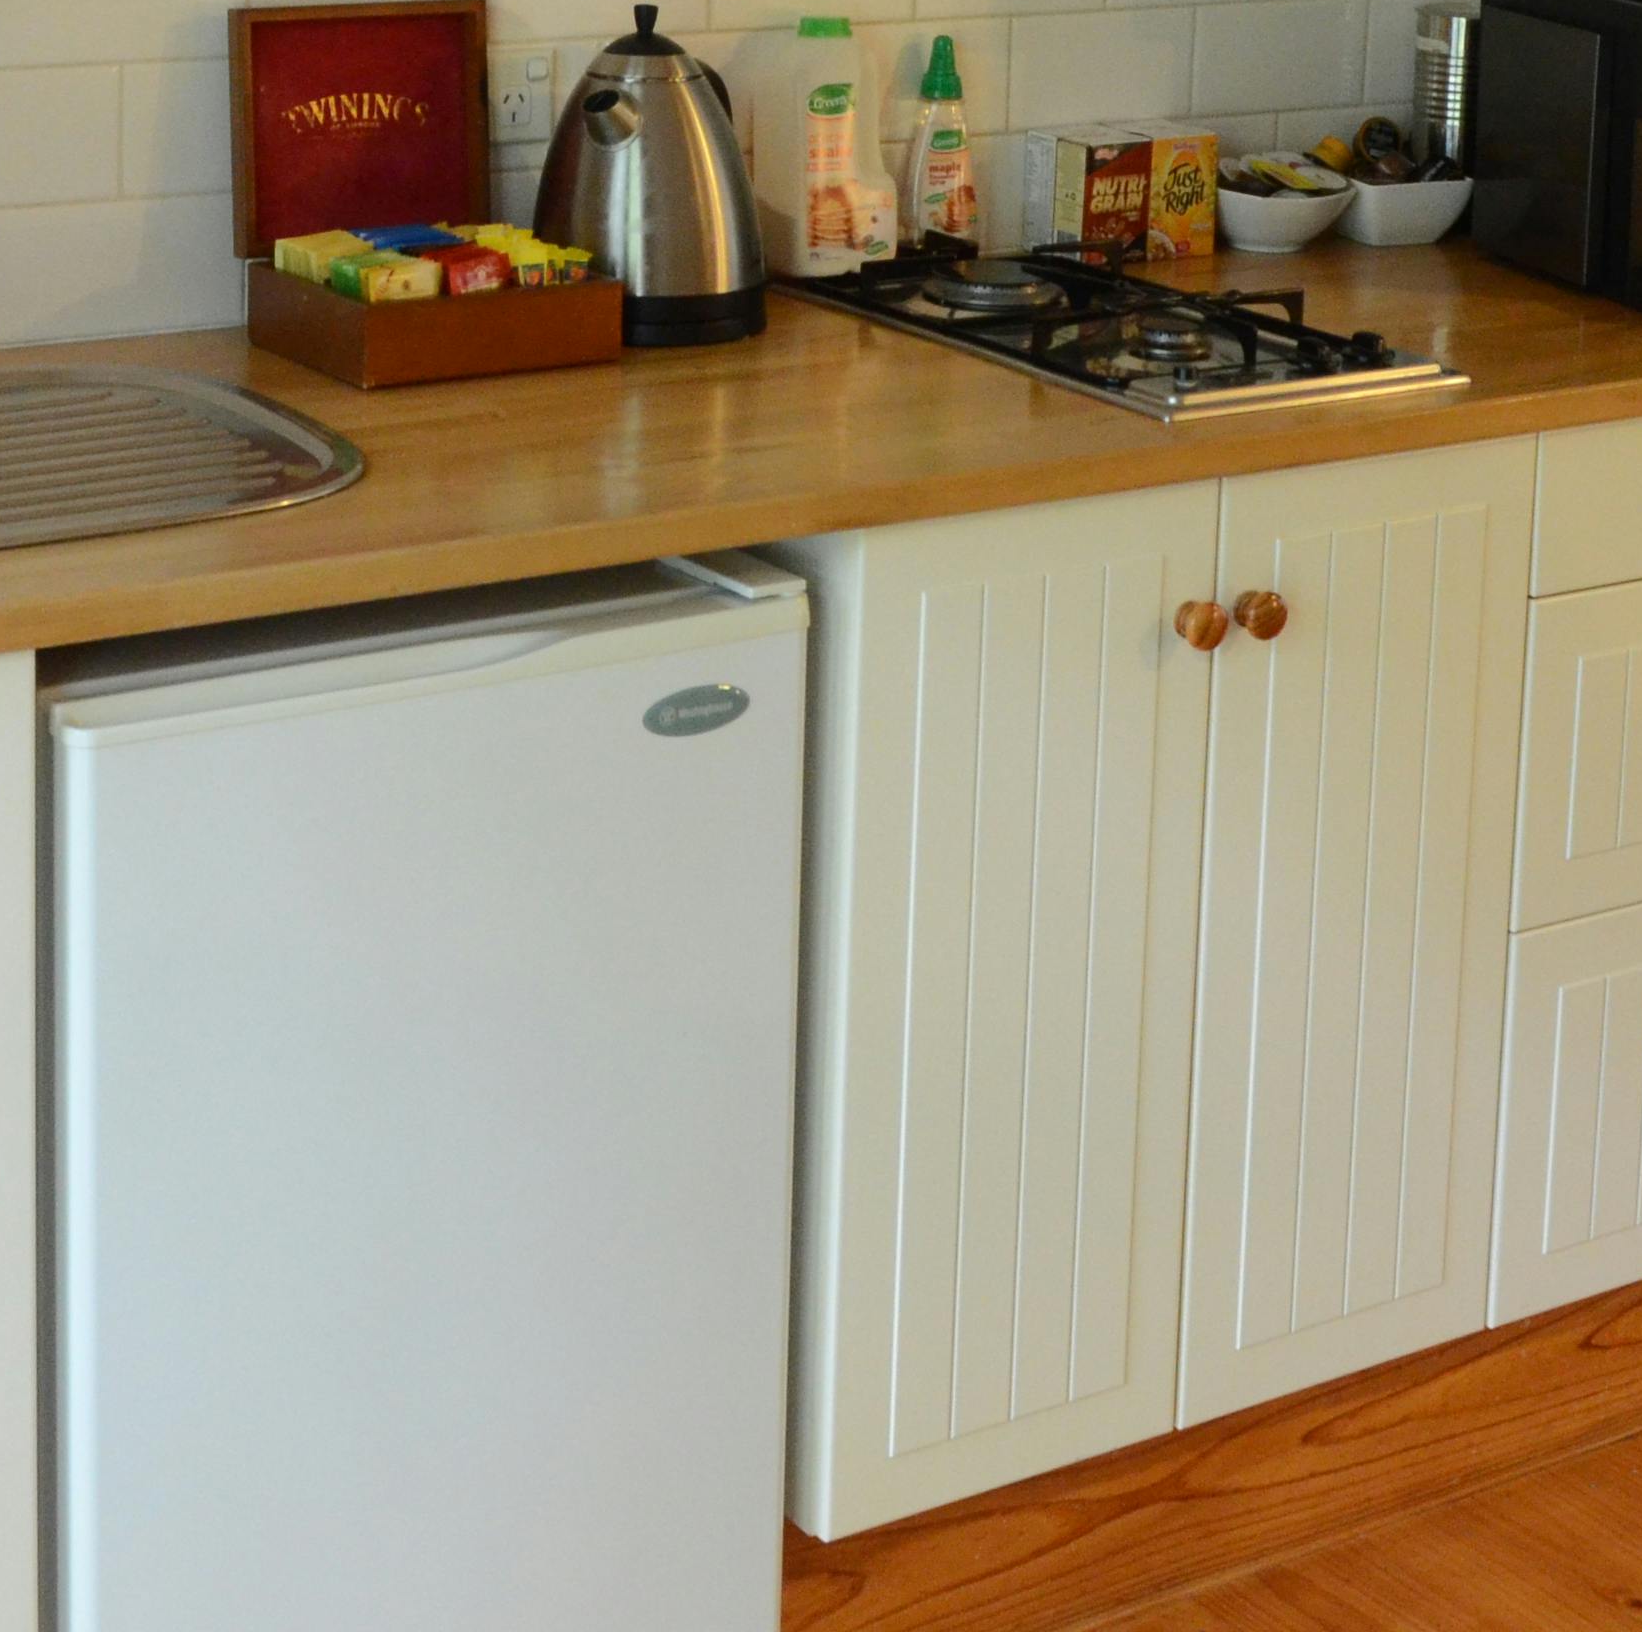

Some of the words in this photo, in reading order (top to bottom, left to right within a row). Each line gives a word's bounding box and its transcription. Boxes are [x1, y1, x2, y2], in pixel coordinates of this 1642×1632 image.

[1164, 161, 1203, 192] Just
[1090, 192, 1144, 214] GRAIN
[1162, 182, 1205, 216] Right
